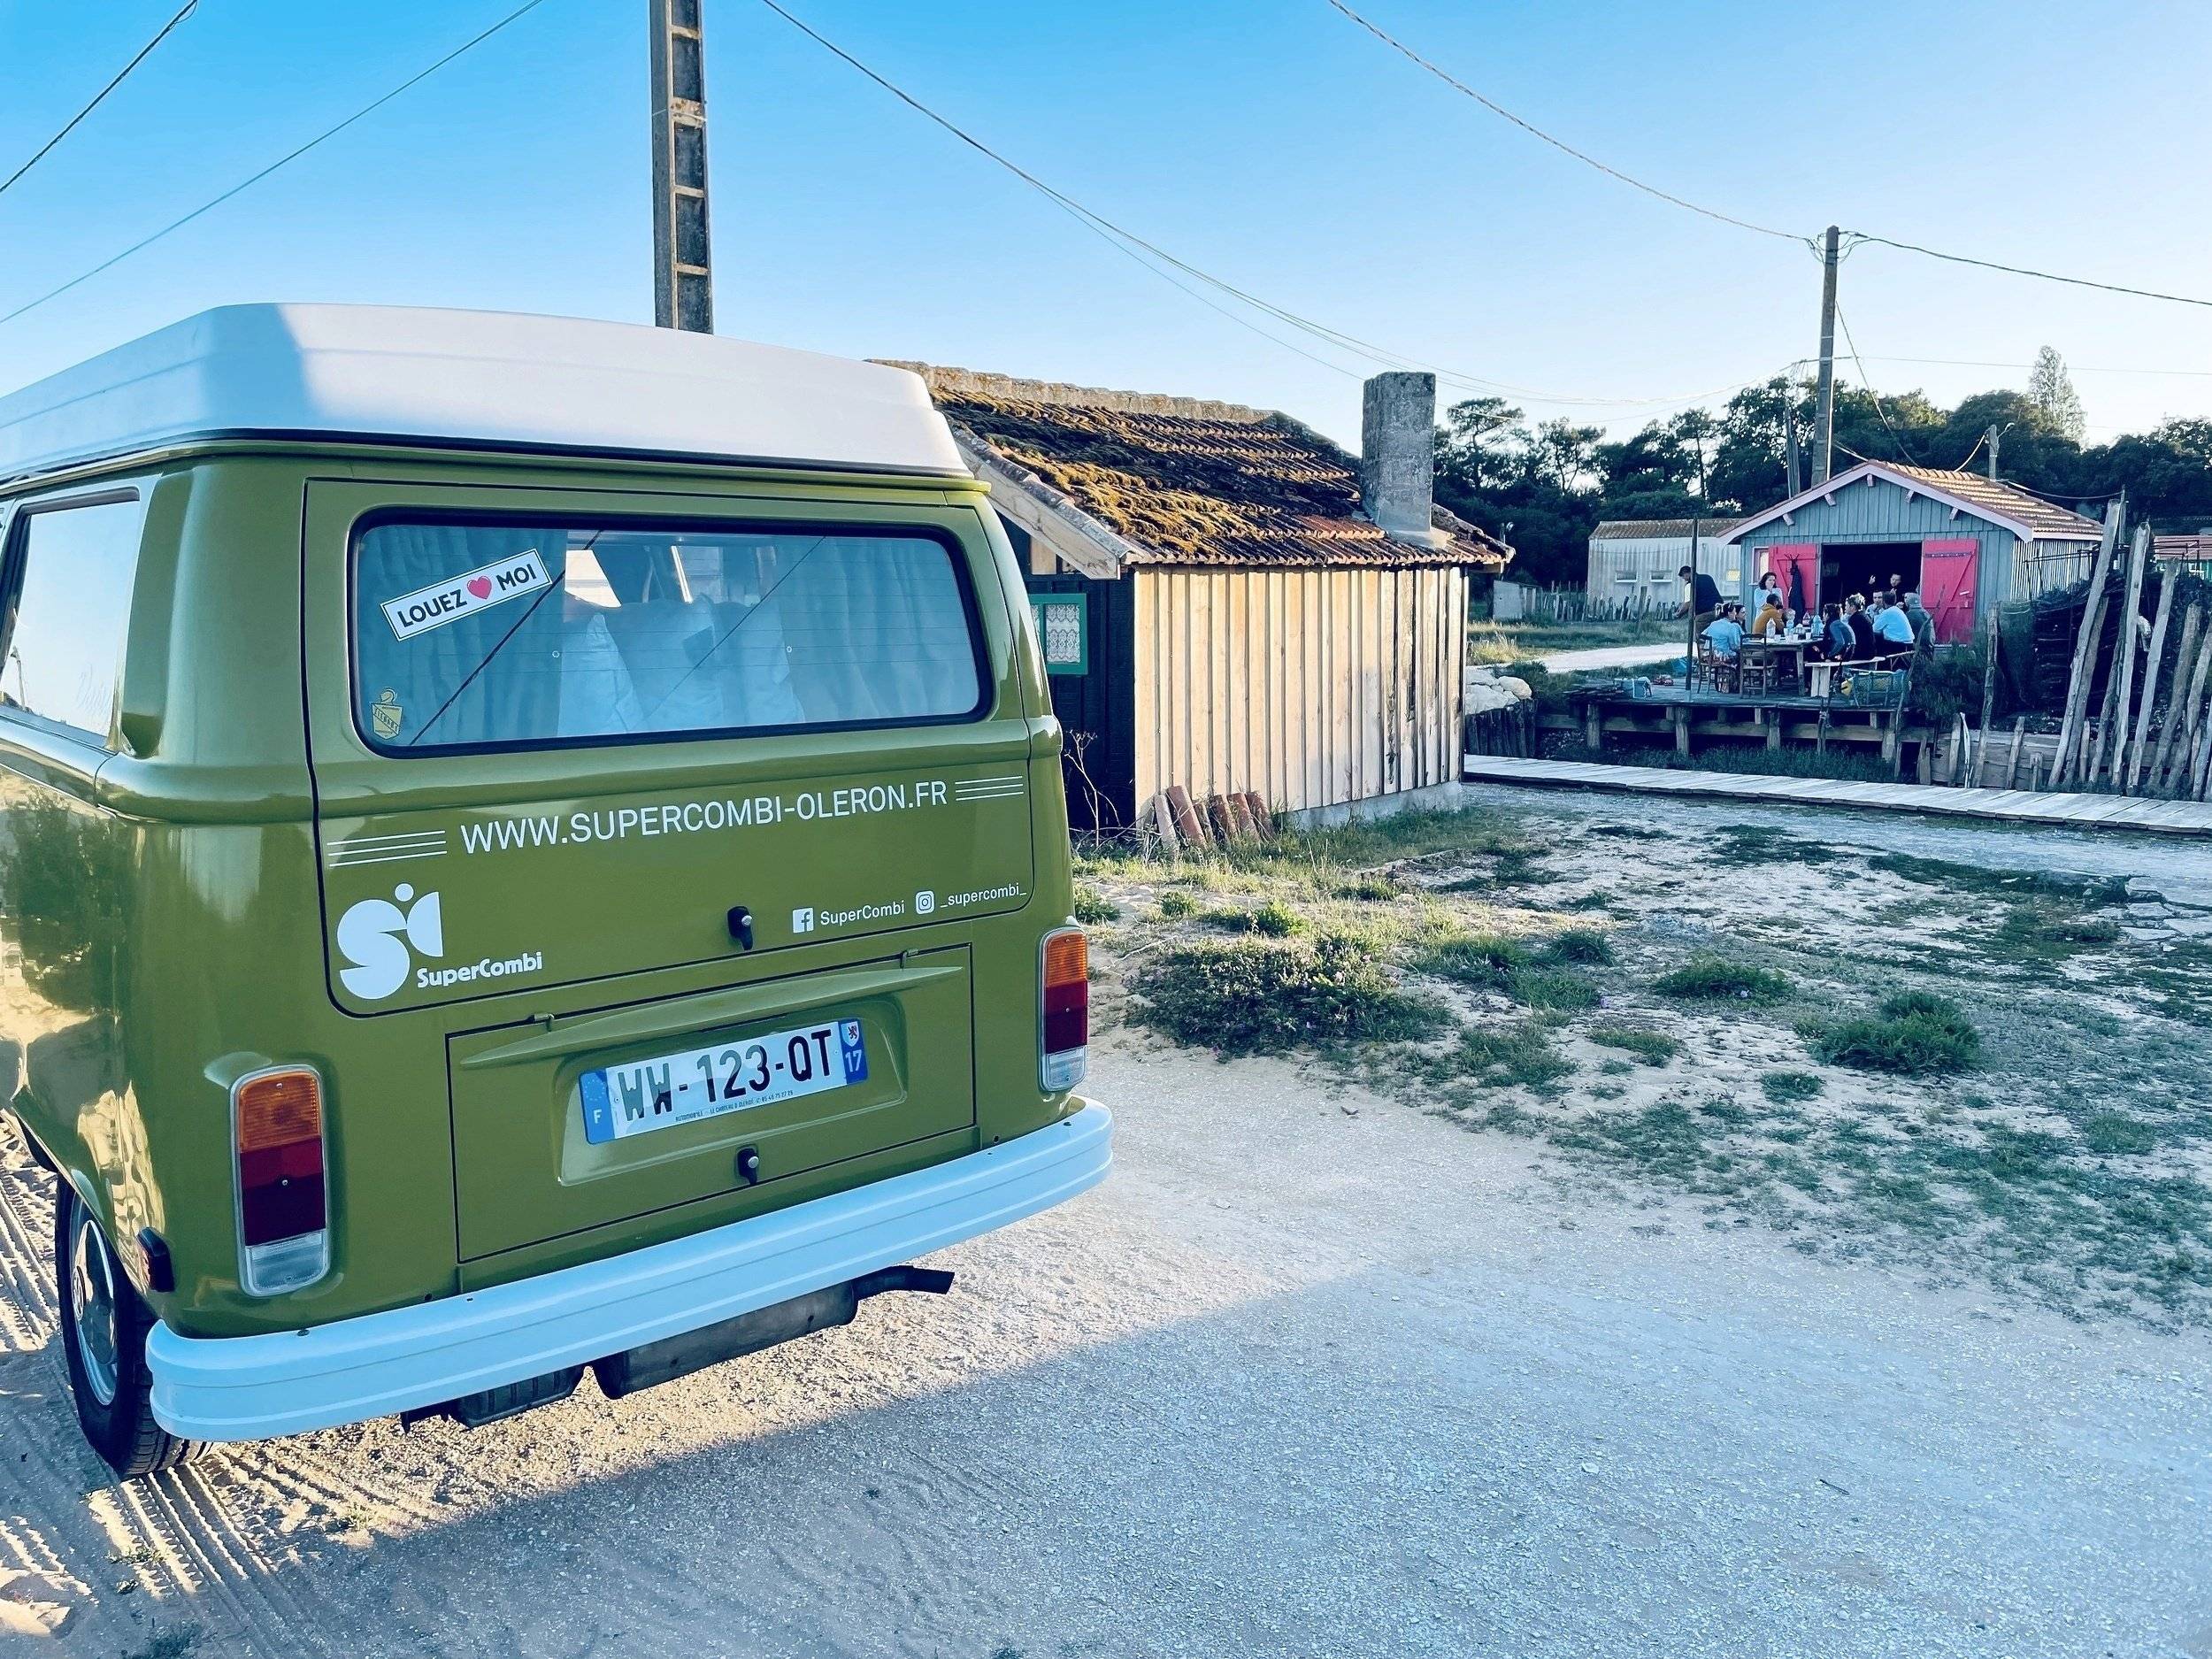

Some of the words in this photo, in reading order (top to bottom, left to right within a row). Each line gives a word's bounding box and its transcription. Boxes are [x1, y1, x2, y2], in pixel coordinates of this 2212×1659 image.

[397, 589, 467, 627] LOUEZ
[495, 564, 537, 591] MOI
[460, 780, 949, 855] WWW.SUPERCOMBI-OLERON.FR
[940, 882, 1027, 909] _supercombi_
[820, 899, 905, 926] SuperCombi
[417, 951, 543, 988] SuperCombi
[618, 1029, 832, 1122] WW-123-QT
[845, 1049, 863, 1073] 17
[592, 1109, 603, 1125] F
